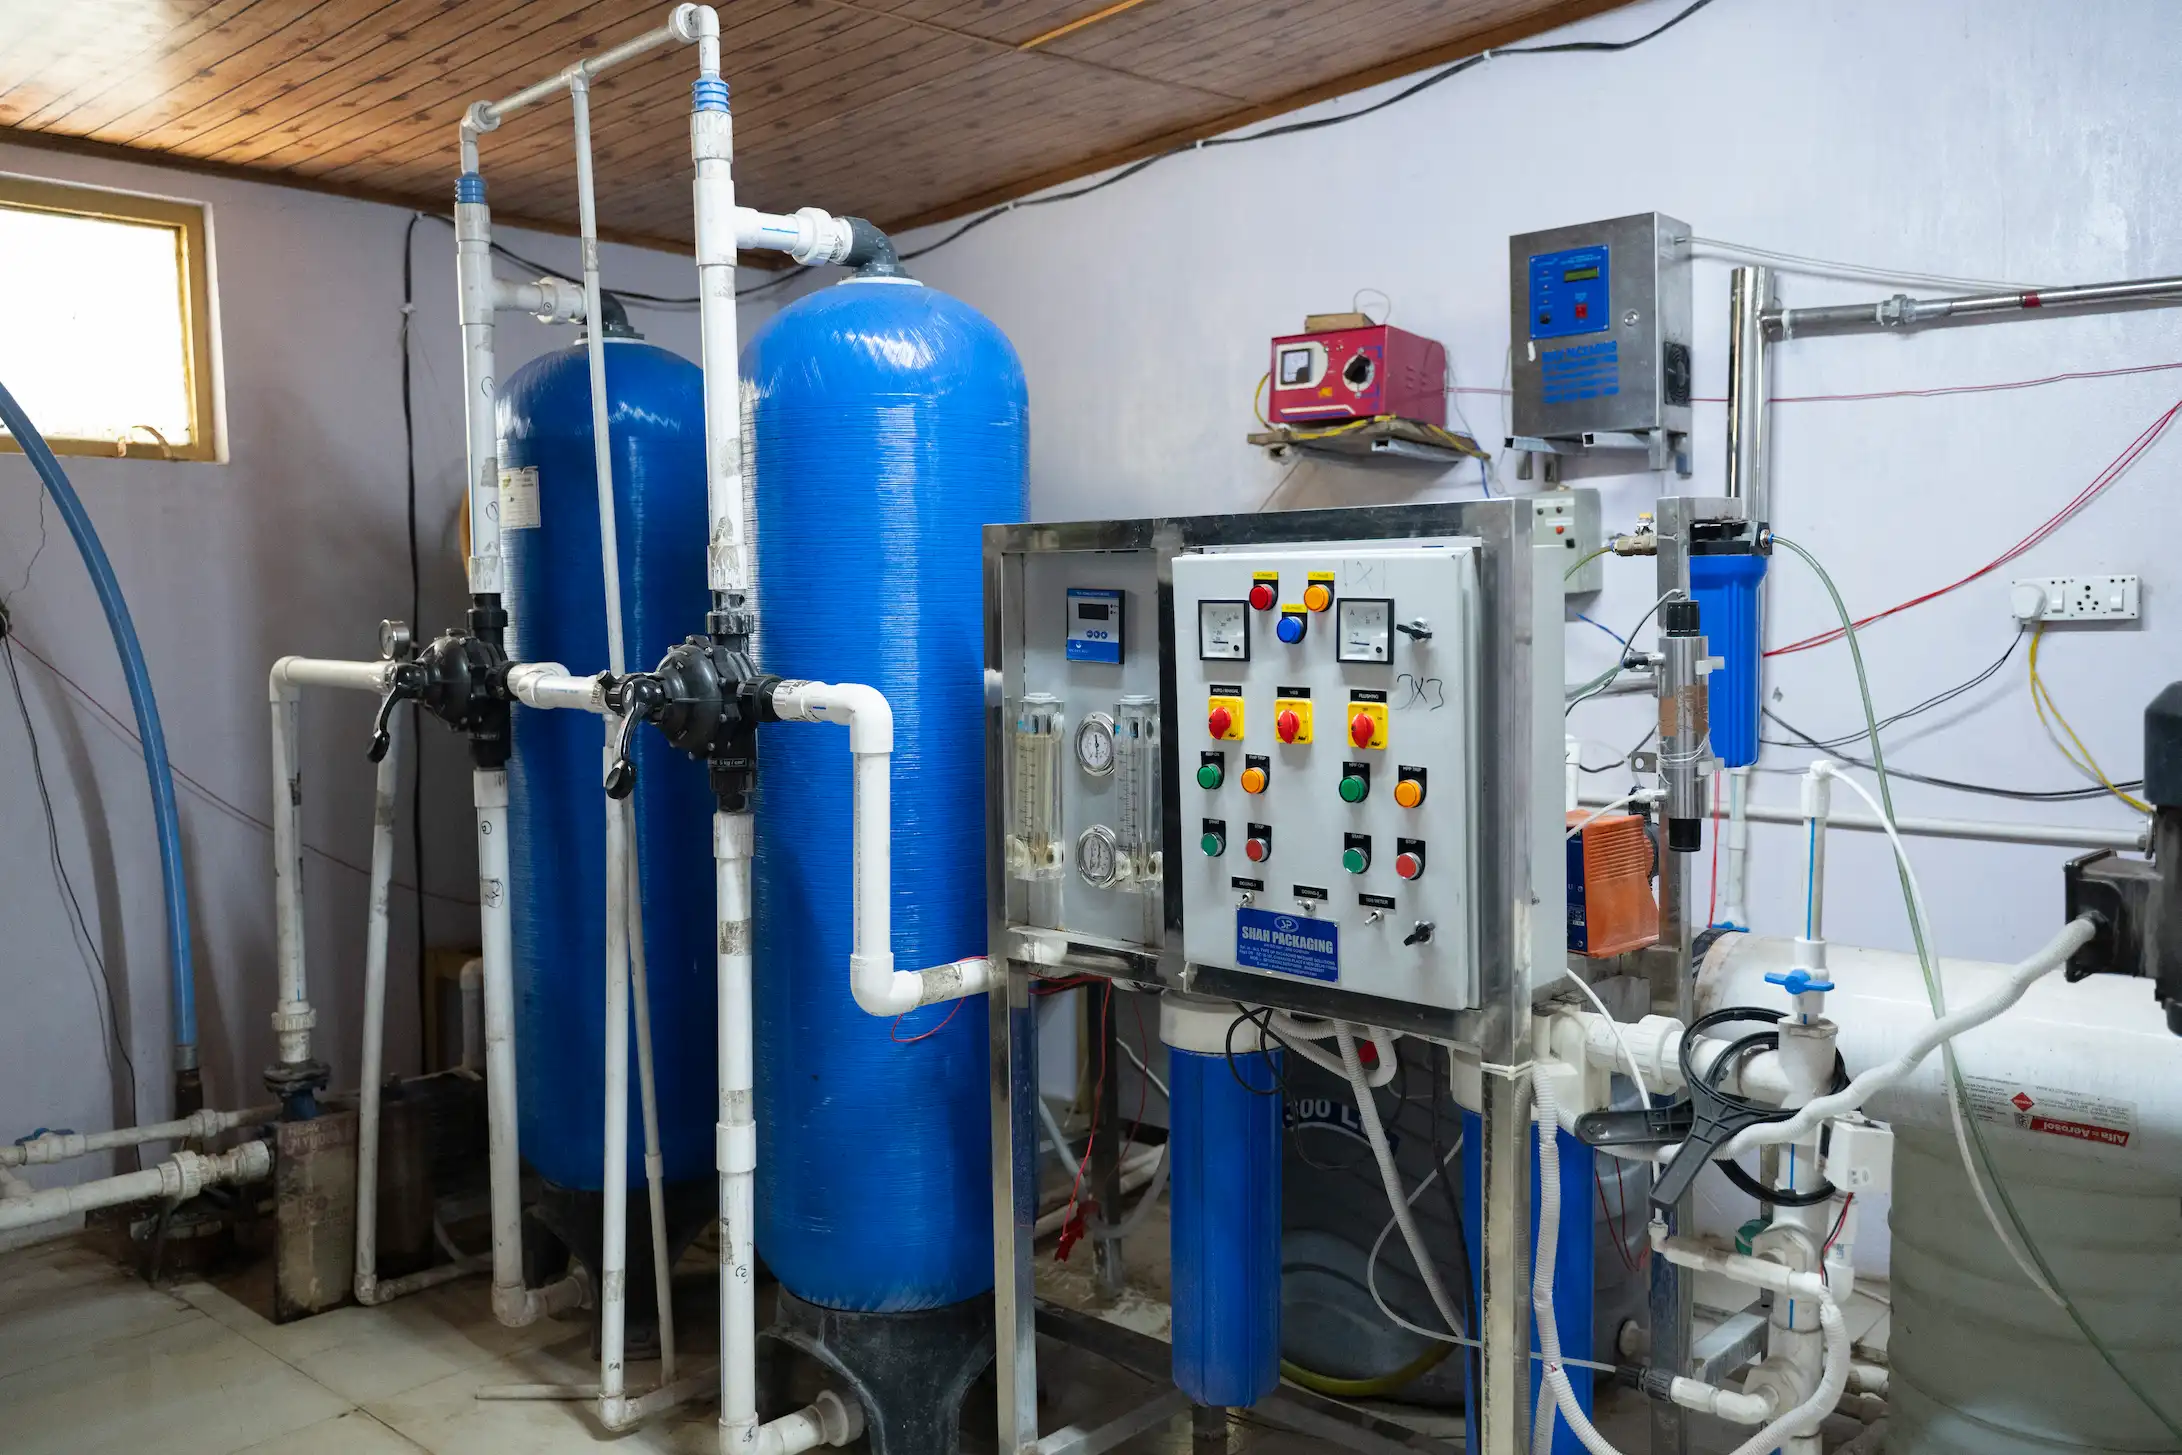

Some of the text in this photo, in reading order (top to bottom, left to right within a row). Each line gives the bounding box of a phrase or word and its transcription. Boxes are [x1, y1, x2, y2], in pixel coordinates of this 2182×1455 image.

[1272, 931, 1334, 954] PACKAGING
[2043, 1121, 2126, 1145] Alfa Aerosol
